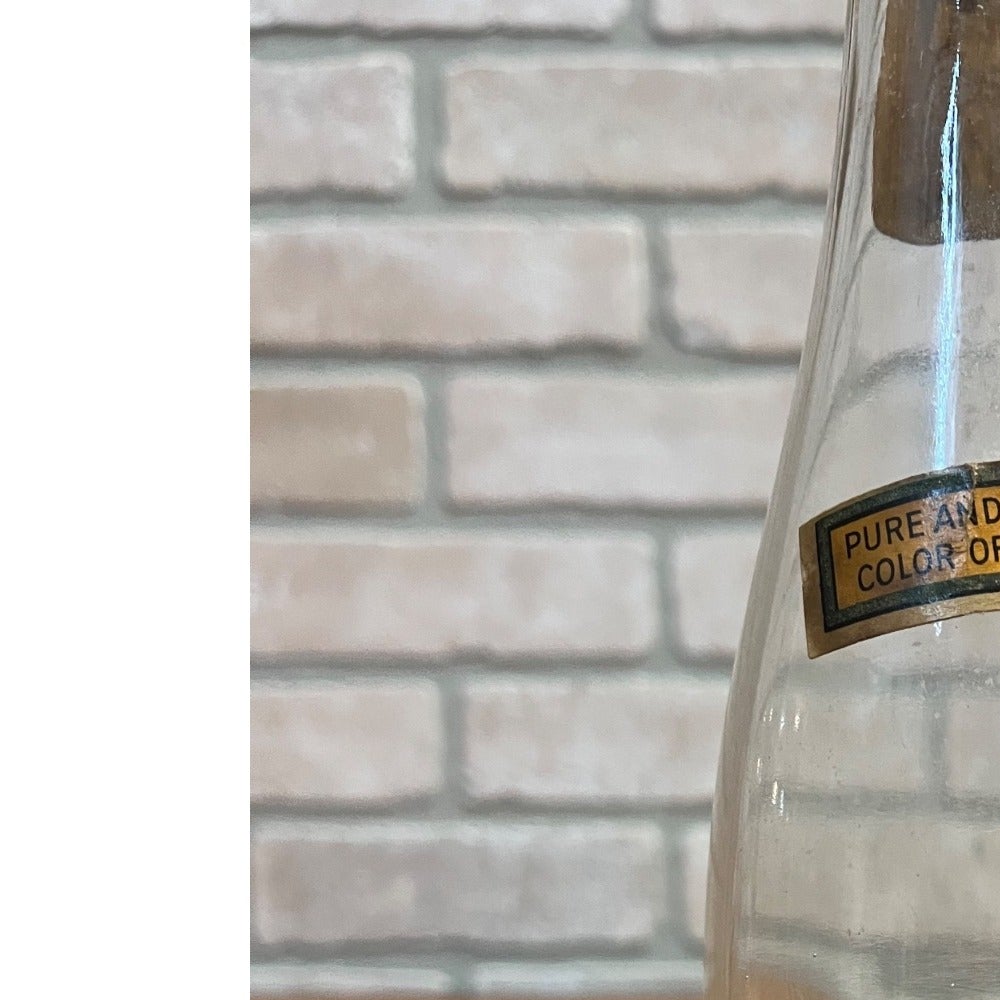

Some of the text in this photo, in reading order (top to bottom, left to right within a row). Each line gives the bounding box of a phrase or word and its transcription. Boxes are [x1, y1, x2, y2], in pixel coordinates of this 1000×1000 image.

[845, 509, 924, 559] PURE
[934, 497, 1000, 531] AND
[857, 543, 956, 592] COLOR
